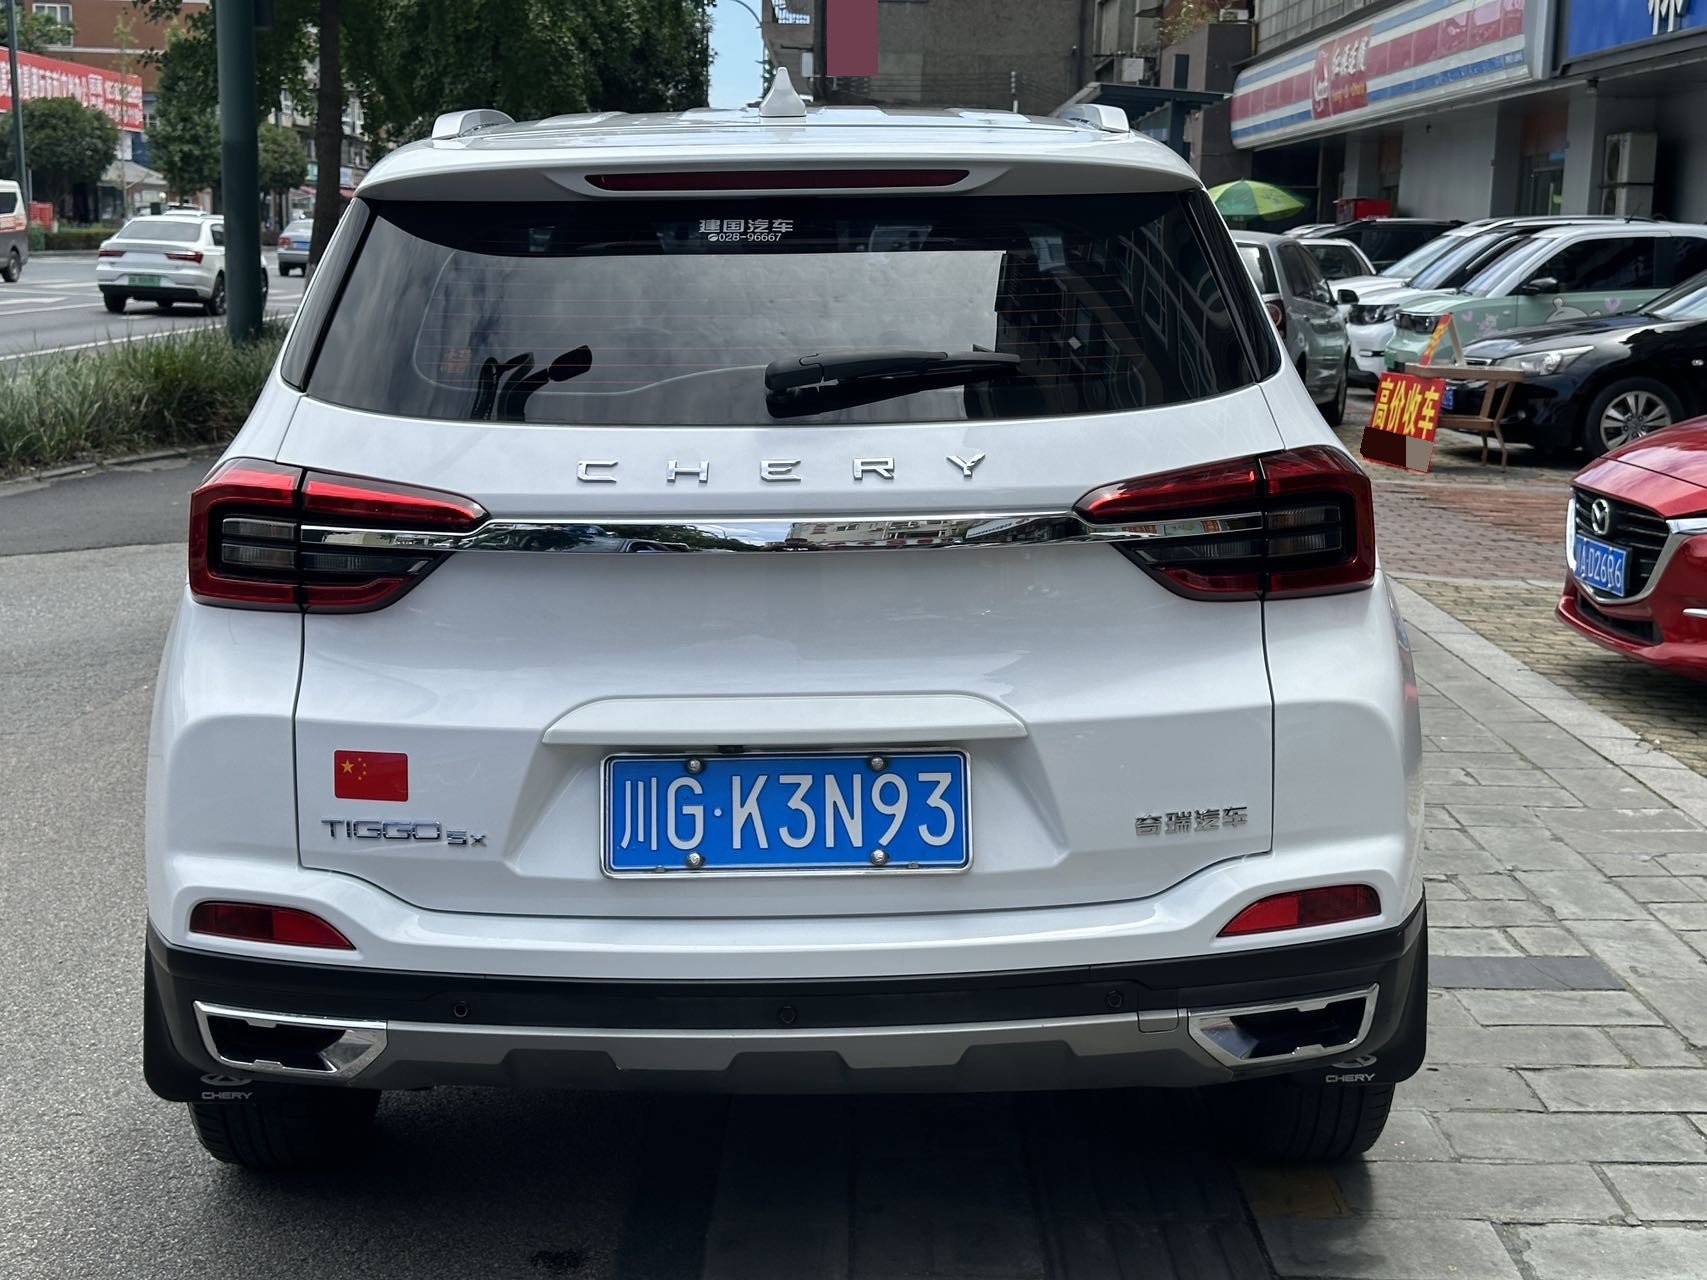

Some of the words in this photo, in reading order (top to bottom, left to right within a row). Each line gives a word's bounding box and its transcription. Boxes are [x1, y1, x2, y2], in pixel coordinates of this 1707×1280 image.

[699, 219, 794, 233] 建国汽车
[718, 233, 782, 242] 028-96667
[1372, 377, 1440, 440] 高价收车
[577, 453, 986, 483] CHERY
[620, 772, 956, 851] 川G·K3N93
[1135, 806, 1248, 836] 奇瑞汽车
[321, 820, 441, 839] TIGGO
[1325, 1073, 1376, 1083] CHERY
[201, 1091, 253, 1100] CHERY
